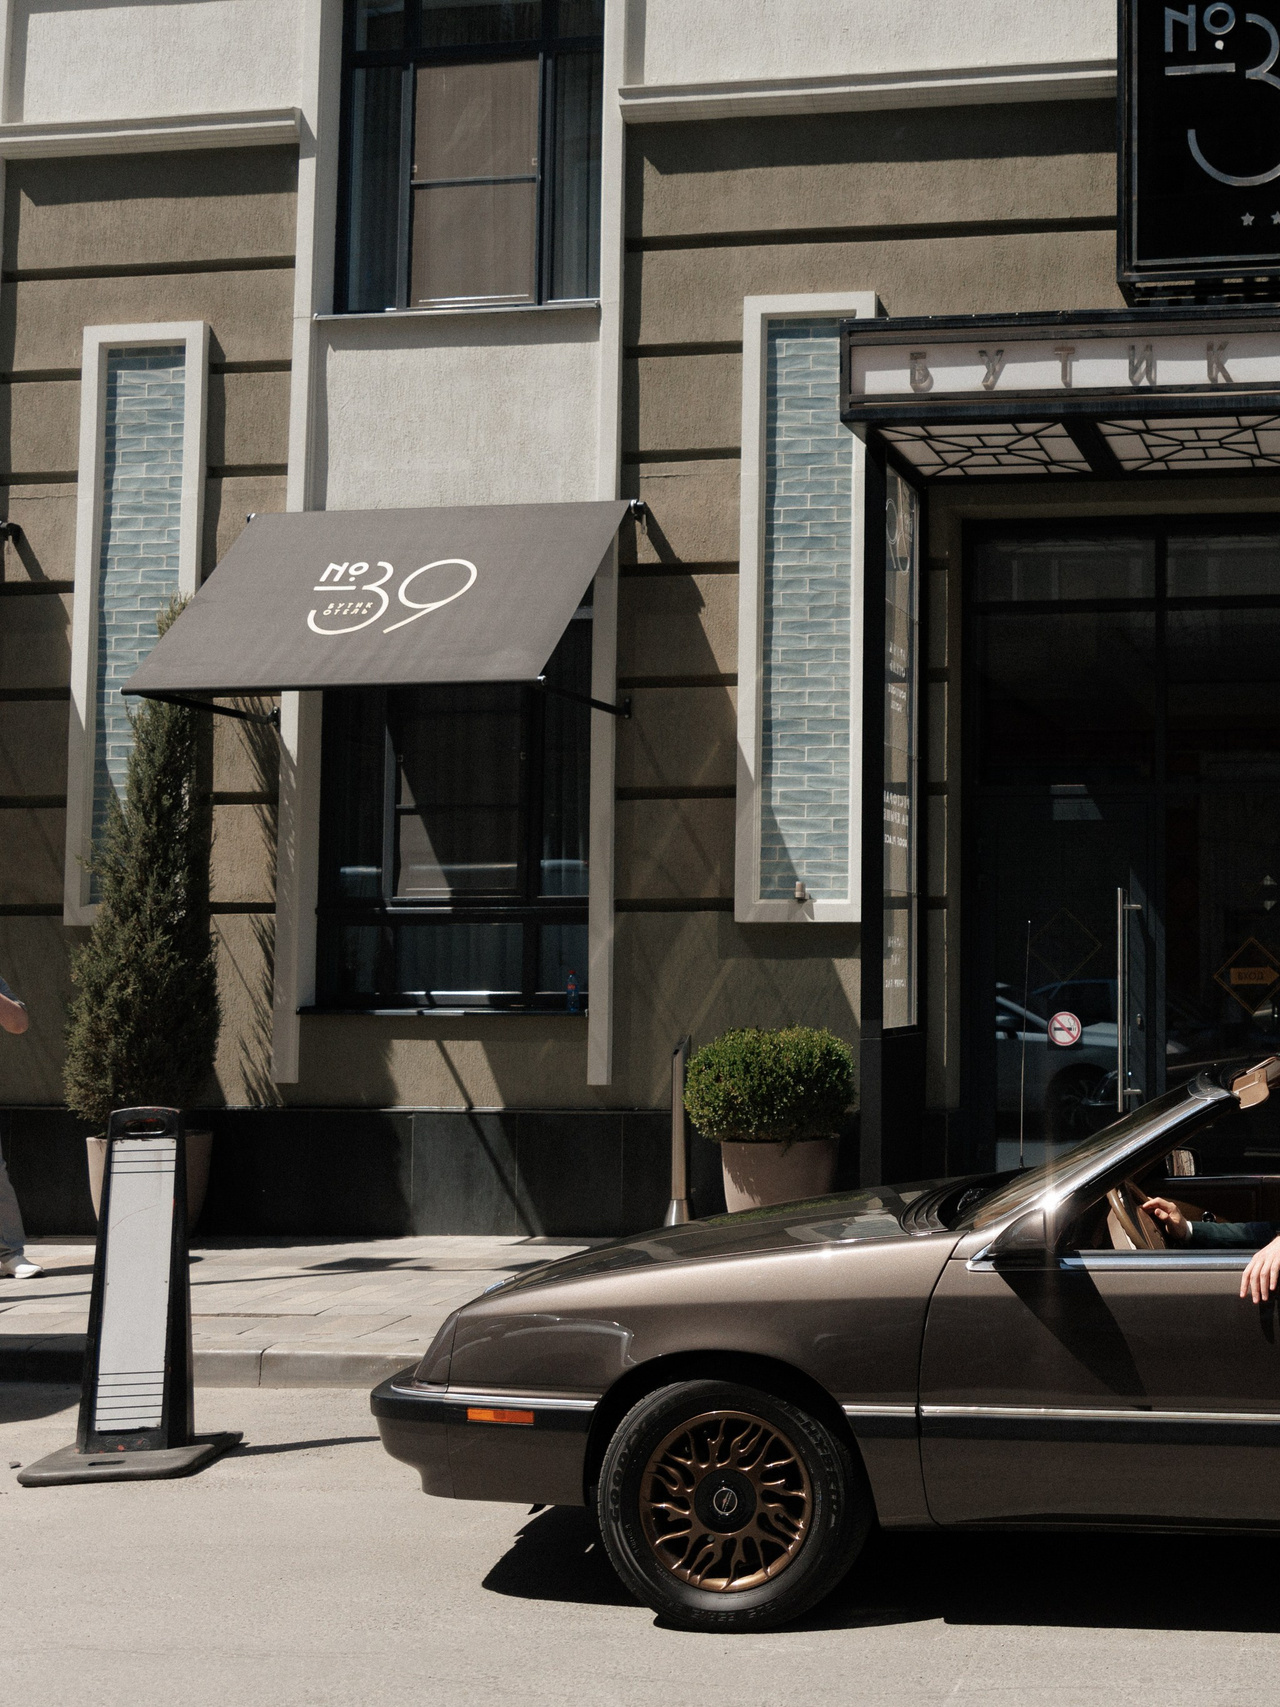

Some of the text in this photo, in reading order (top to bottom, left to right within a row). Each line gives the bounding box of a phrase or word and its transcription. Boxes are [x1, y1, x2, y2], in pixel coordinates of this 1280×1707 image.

[909, 340, 1234, 394] БУТИК
[306, 558, 478, 636] 39
[322, 608, 369, 616] ОТЕЛЬ
[1237, 971, 1264, 981] ВХОД
